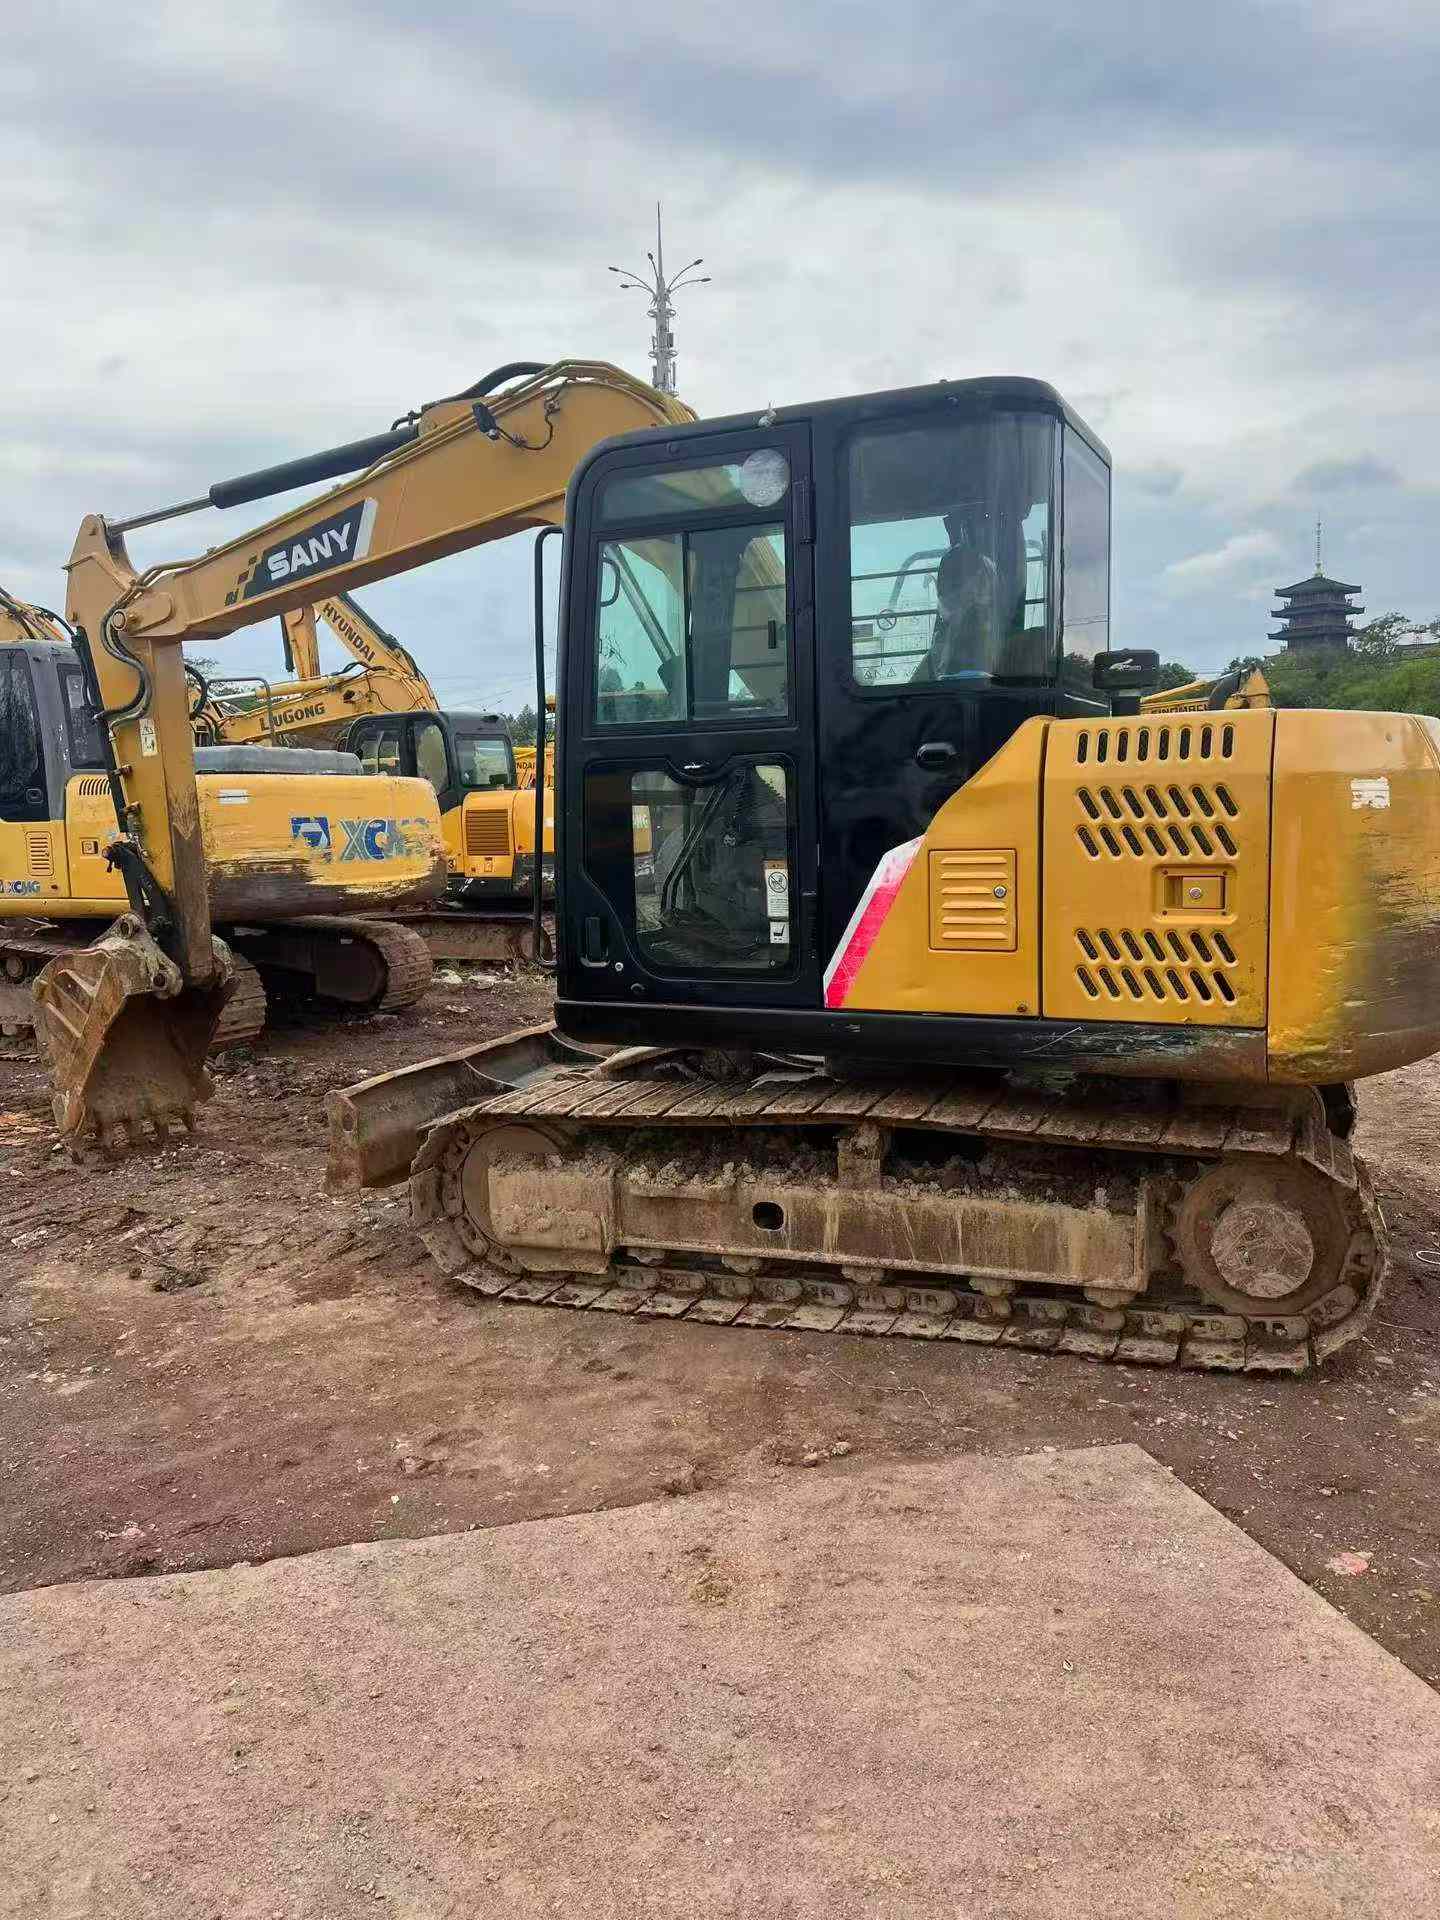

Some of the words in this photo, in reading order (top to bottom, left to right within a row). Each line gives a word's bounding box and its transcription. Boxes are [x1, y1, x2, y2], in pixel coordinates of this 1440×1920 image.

[267, 522, 351, 581] SANY
[322, 602, 376, 662] HYUNDAI
[259, 702, 326, 731] LUGONG
